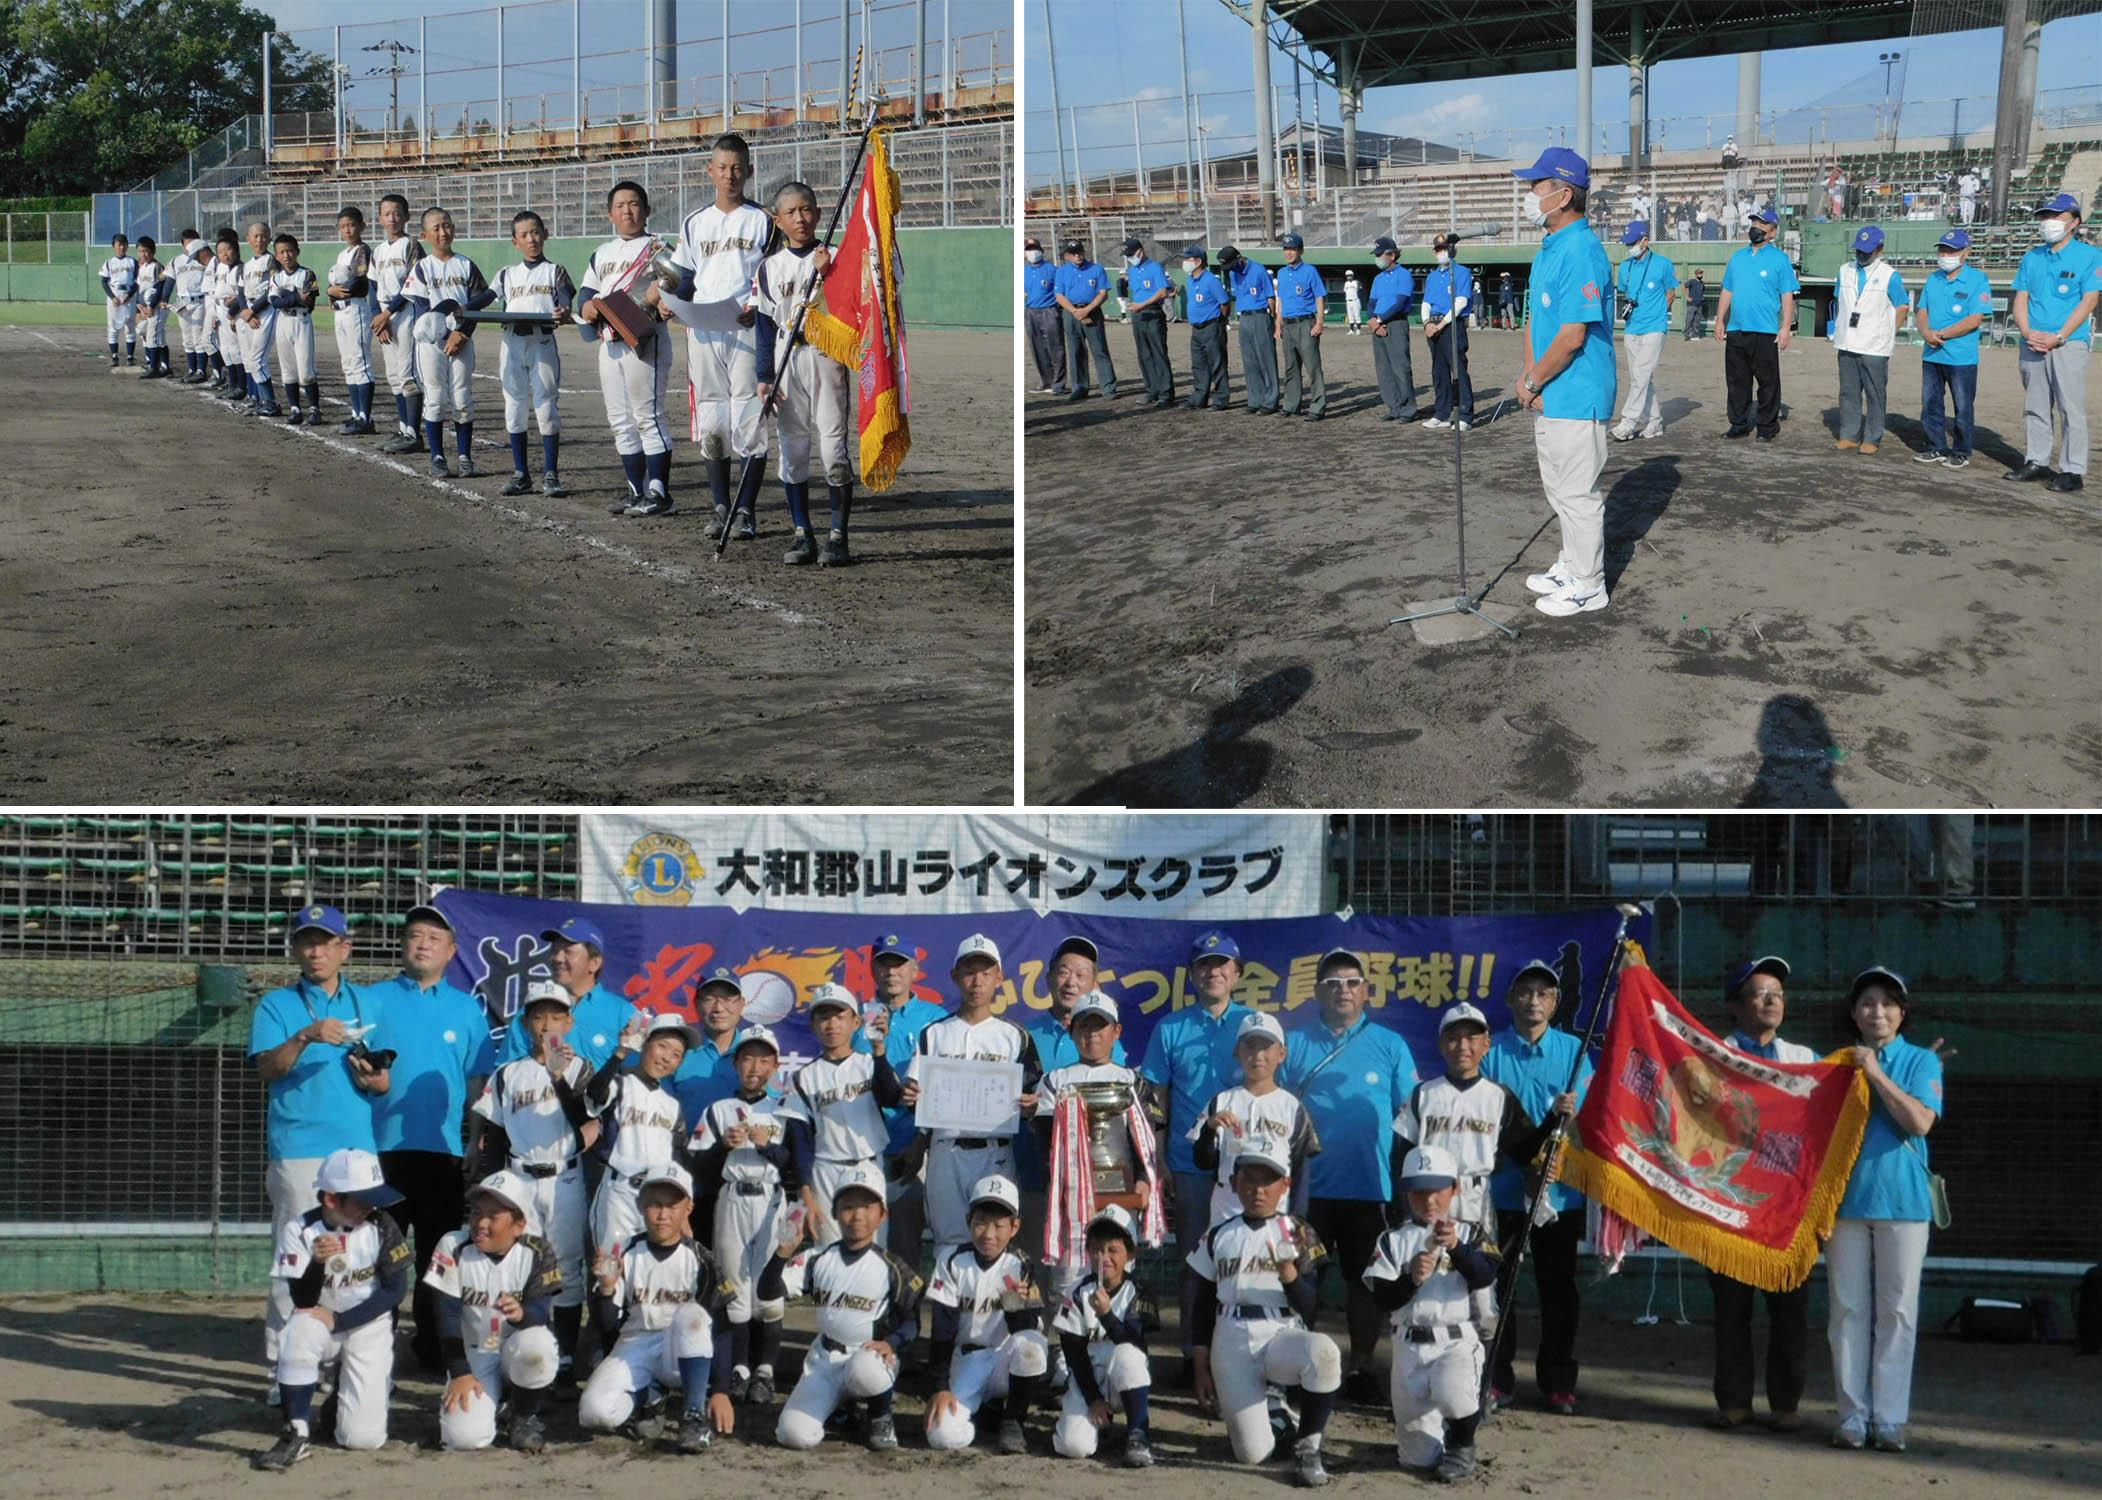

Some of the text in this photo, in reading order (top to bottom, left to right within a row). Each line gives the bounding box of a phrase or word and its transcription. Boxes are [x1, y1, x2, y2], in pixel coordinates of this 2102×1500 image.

[715, 845, 1285, 901] 大和郡山ライオンズクラブ
[1454, 1116, 1497, 1135] ANGELS
